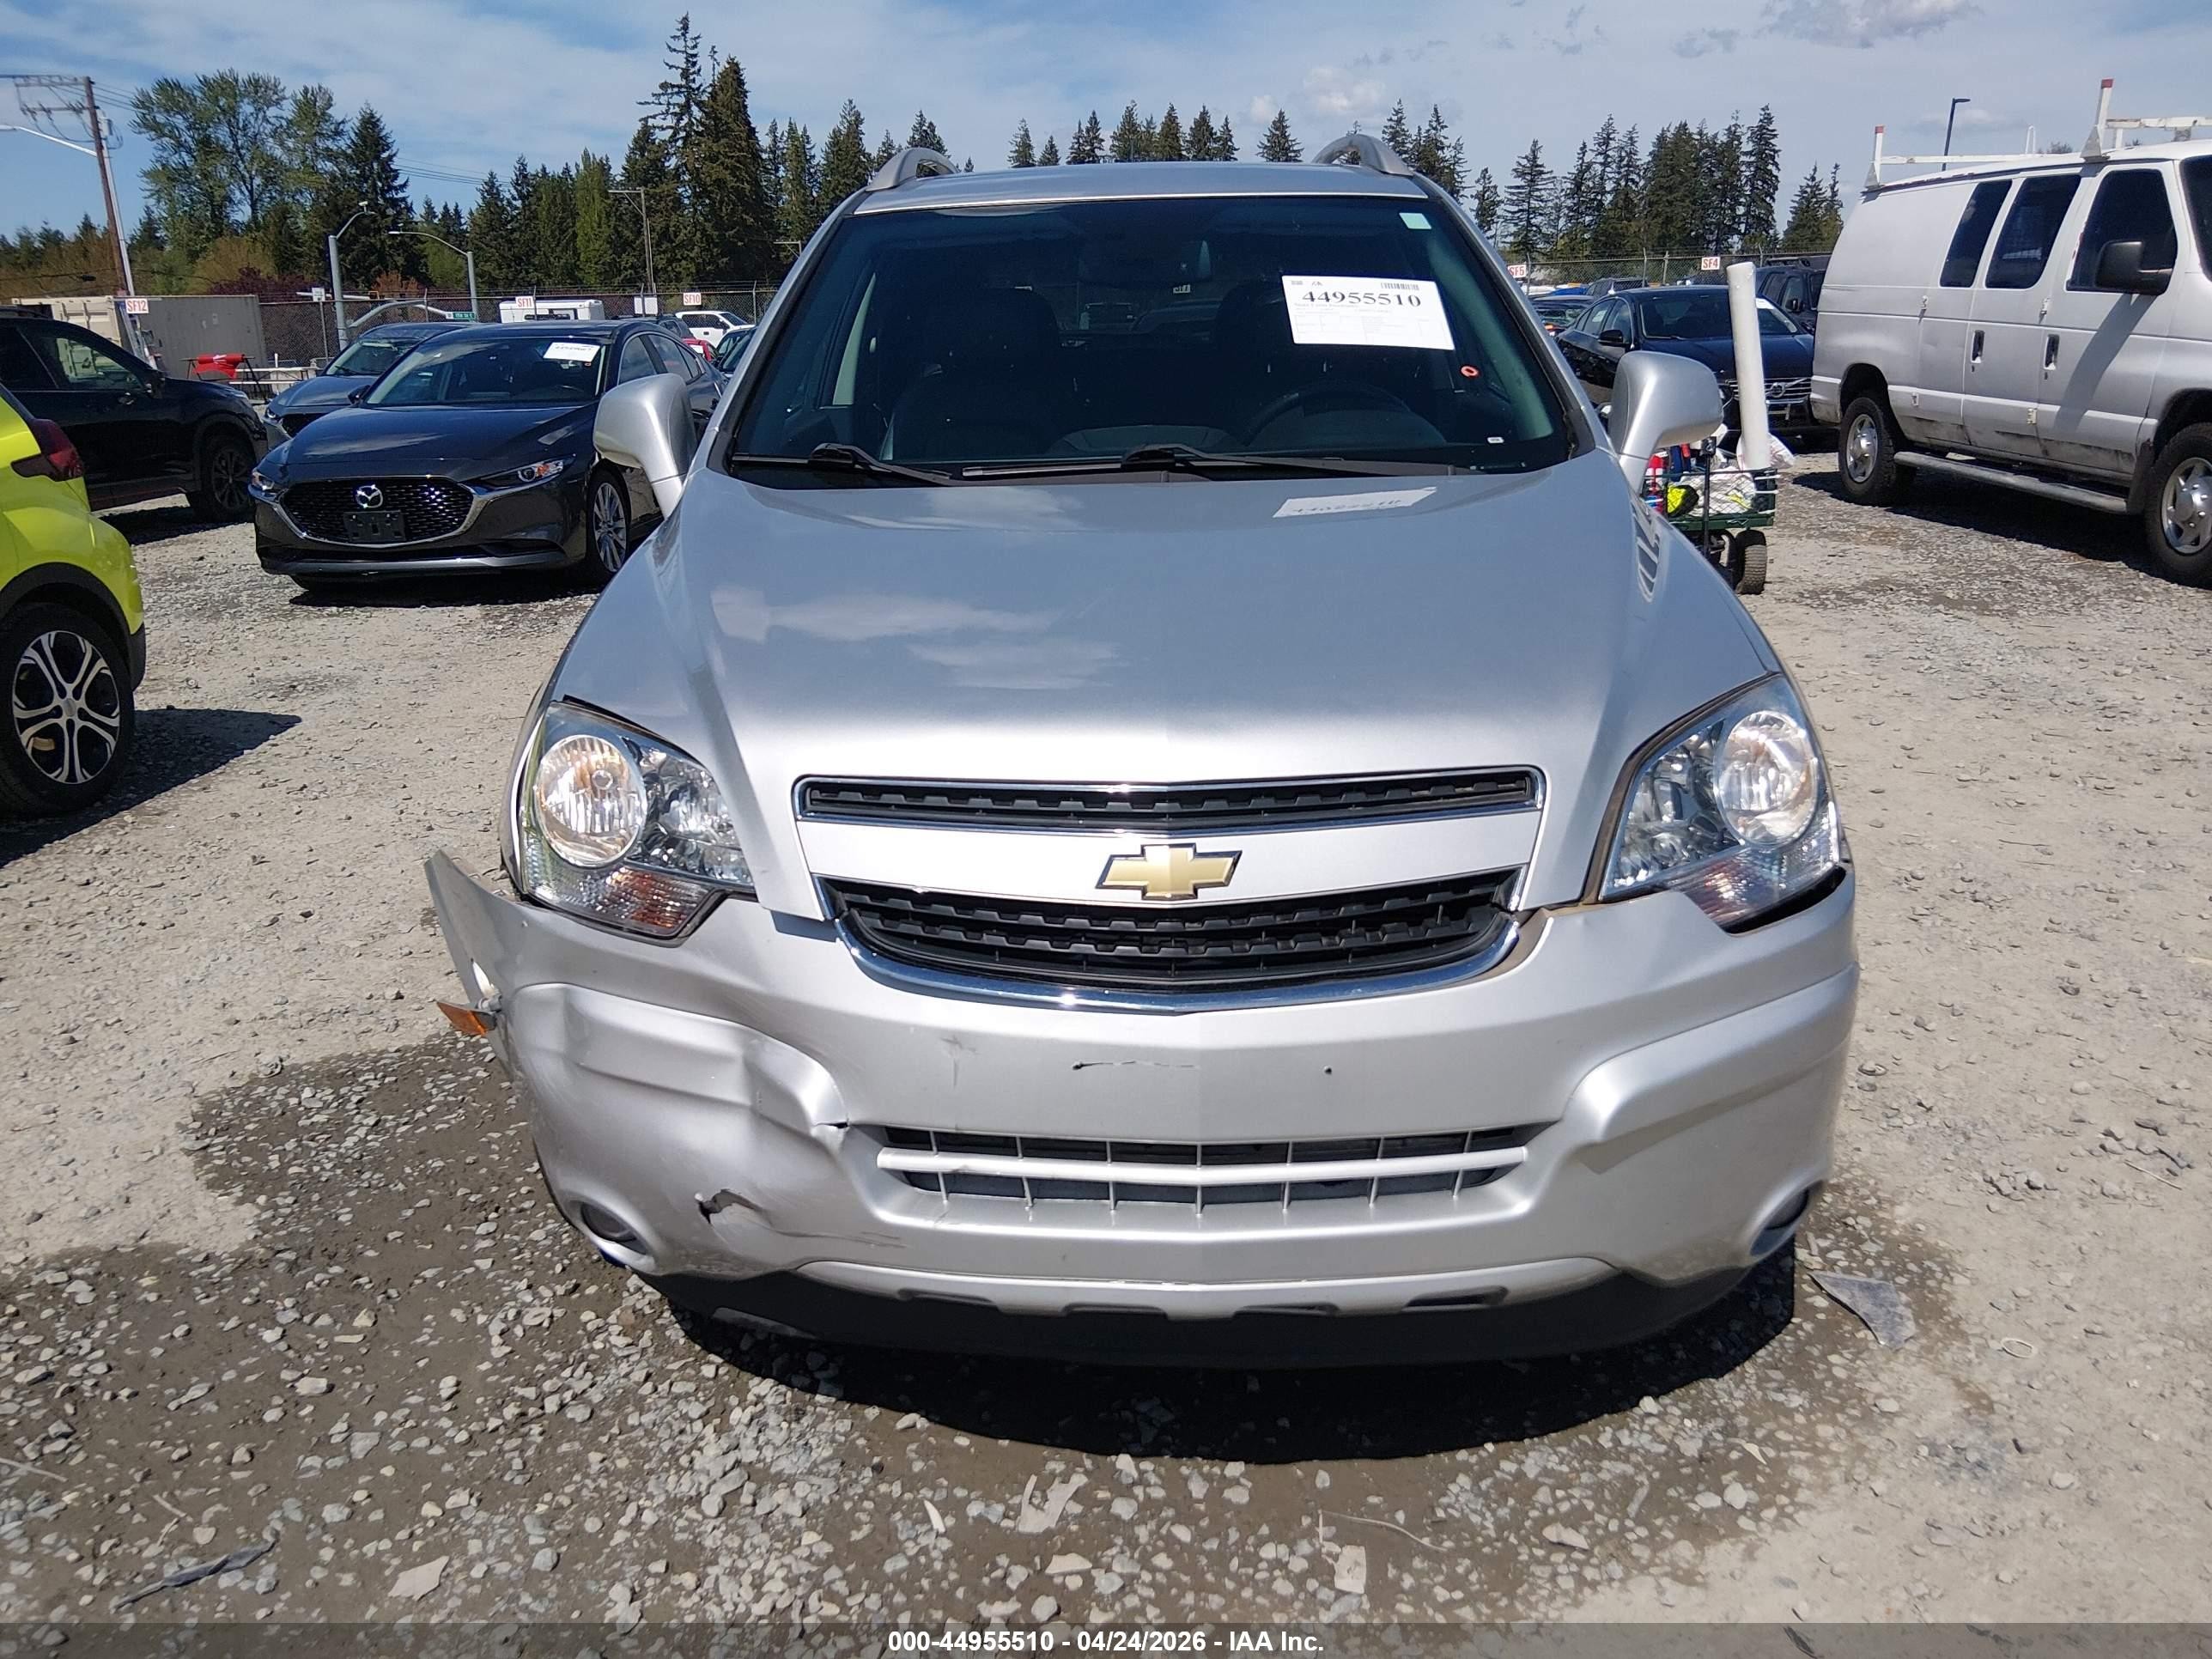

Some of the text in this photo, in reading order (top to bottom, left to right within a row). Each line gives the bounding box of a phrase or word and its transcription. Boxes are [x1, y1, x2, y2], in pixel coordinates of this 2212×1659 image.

[1703, 258, 1718, 269] SF4
[1509, 266, 1525, 276] SF5
[517, 297, 532, 307] SF11
[684, 294, 701, 304] SF10
[1302, 290, 1421, 307] 44955510
[126, 300, 148, 312] SF12
